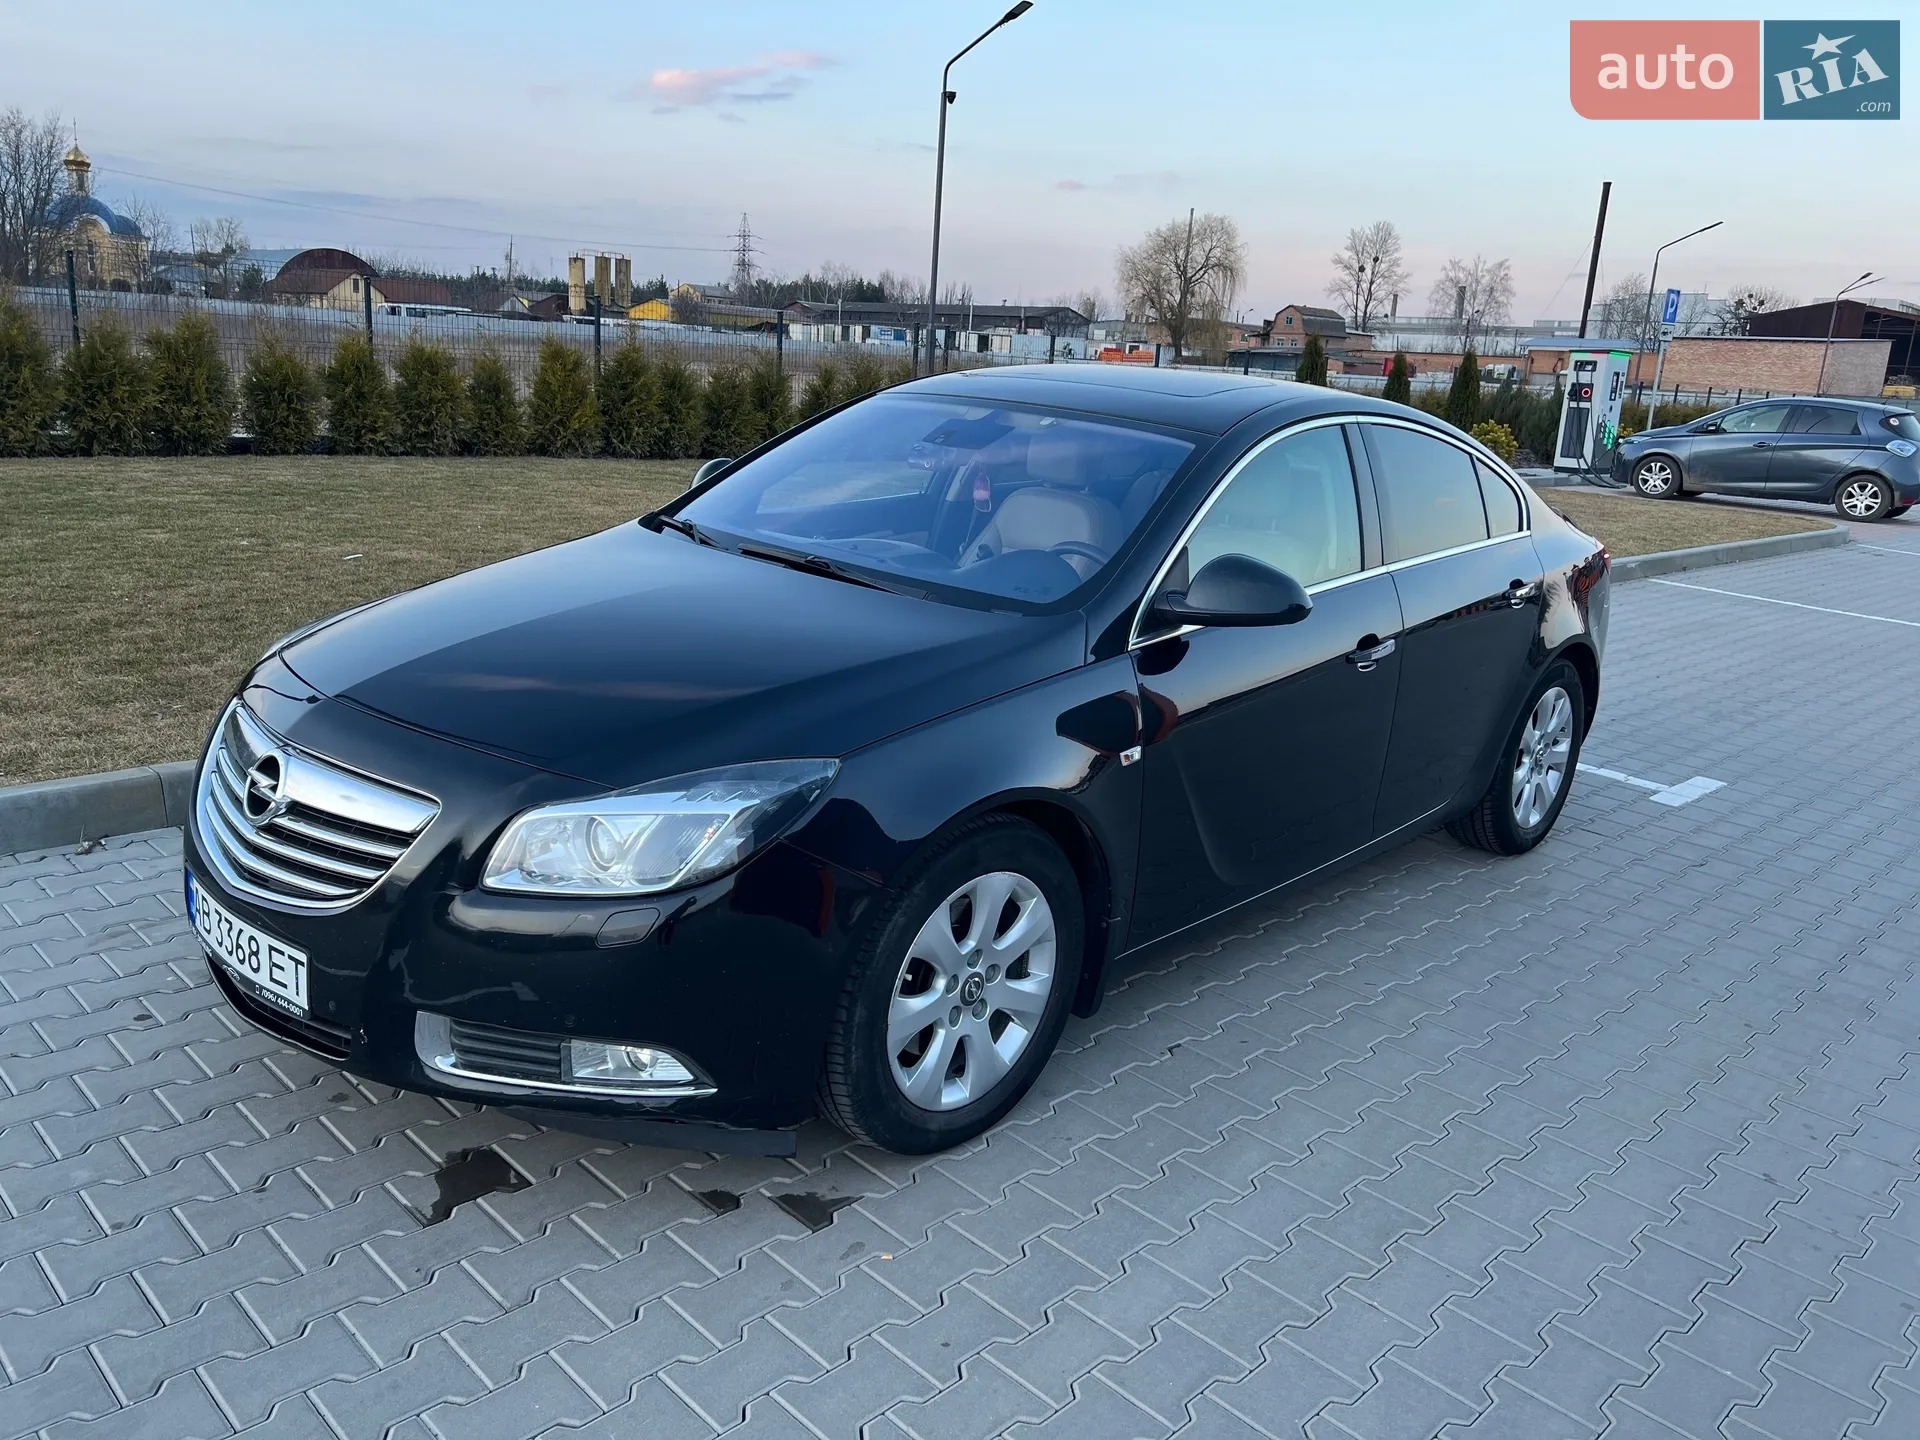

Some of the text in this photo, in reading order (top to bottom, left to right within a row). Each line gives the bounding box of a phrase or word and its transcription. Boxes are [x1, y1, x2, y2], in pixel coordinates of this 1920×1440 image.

[1666, 293, 1677, 320] P
[194, 887, 212, 936] AB
[214, 908, 261, 974] 3368
[268, 943, 306, 998] ET
